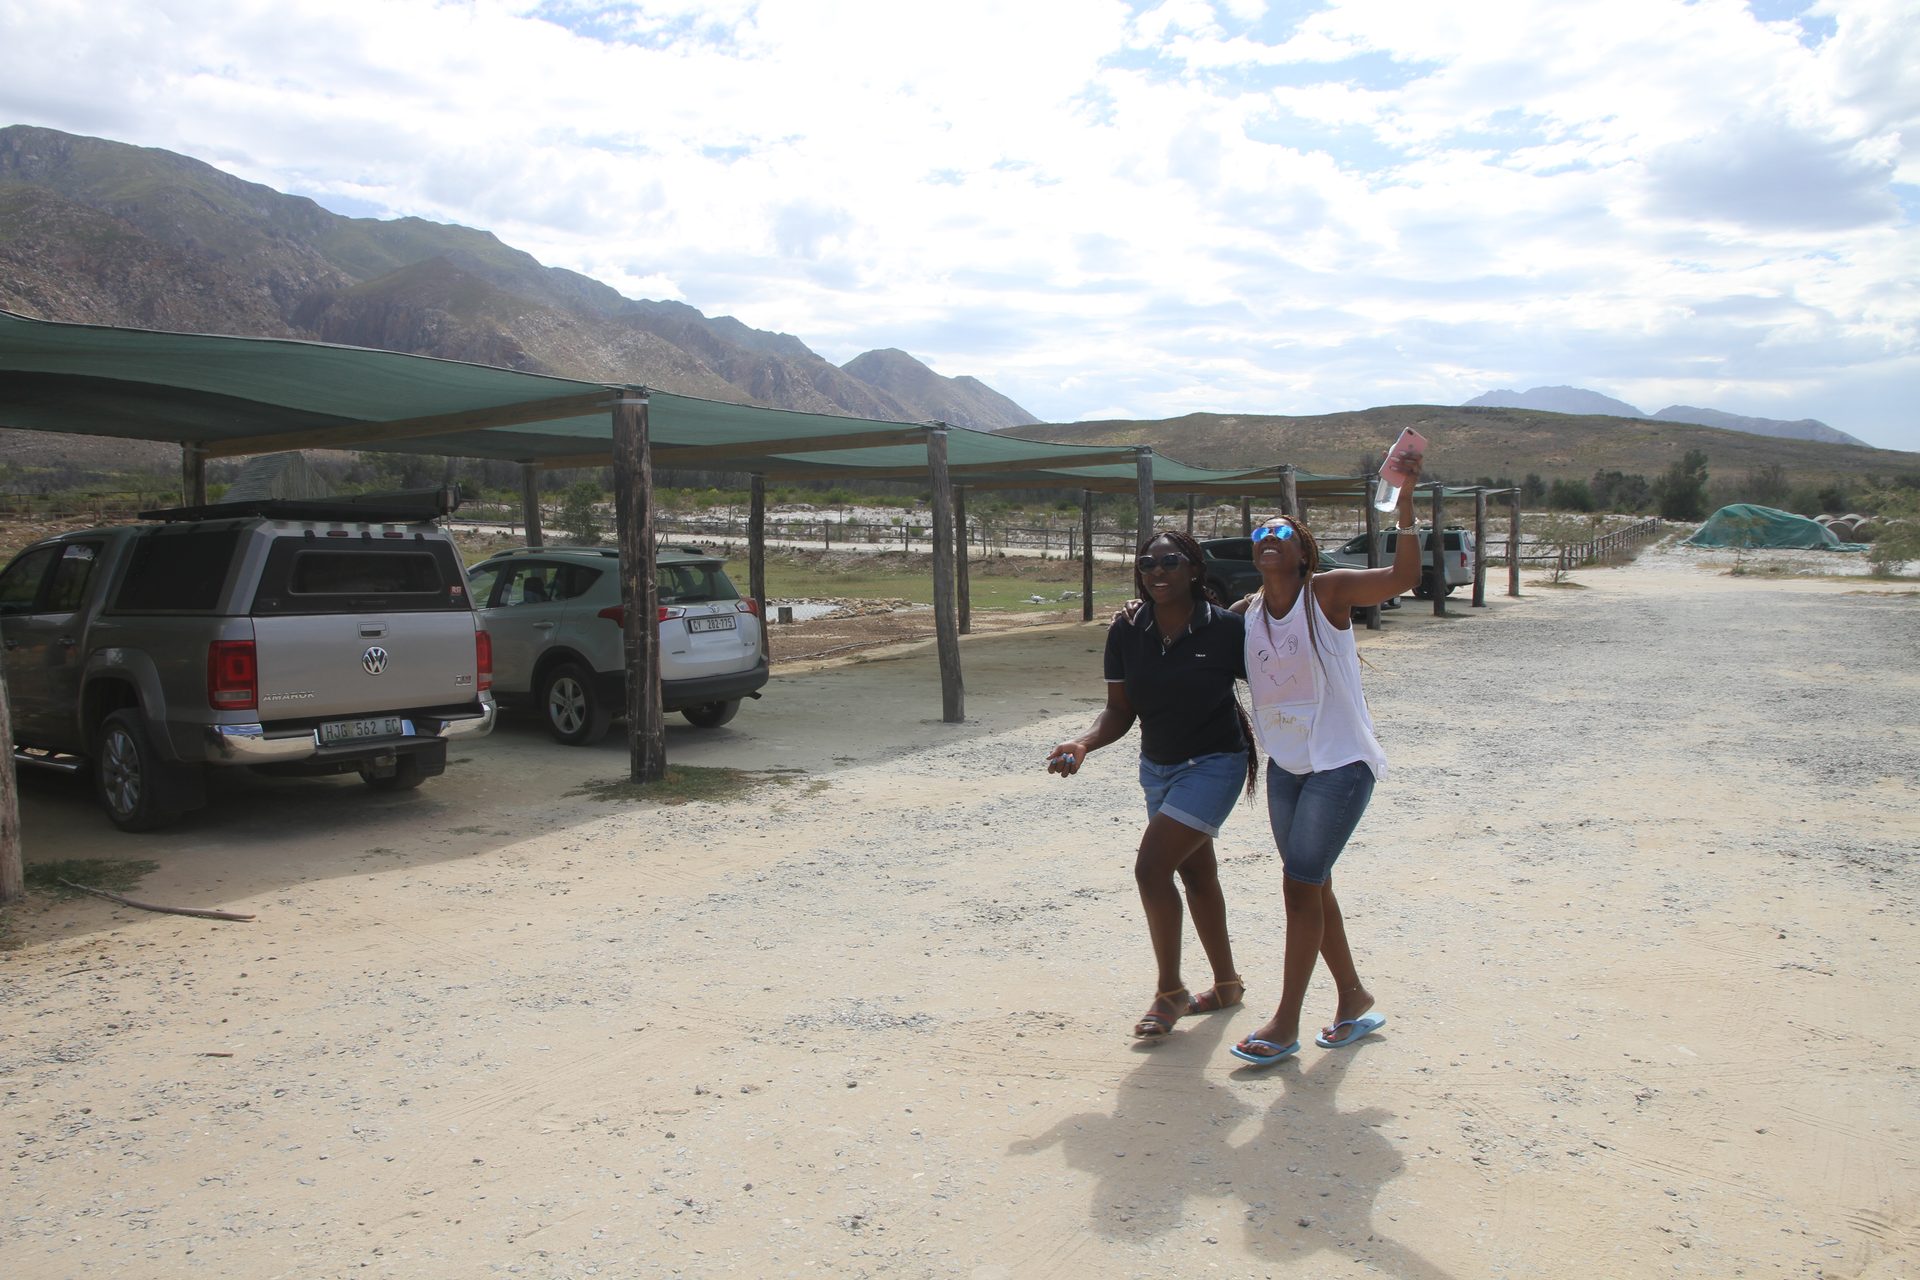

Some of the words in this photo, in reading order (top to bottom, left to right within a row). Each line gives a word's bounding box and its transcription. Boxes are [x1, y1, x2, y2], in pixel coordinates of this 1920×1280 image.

[692, 620, 702, 631] CY
[707, 617, 733, 630] 282-775
[326, 724, 349, 739] HJG
[355, 721, 377, 736] 562
[385, 719, 400, 733] EC
